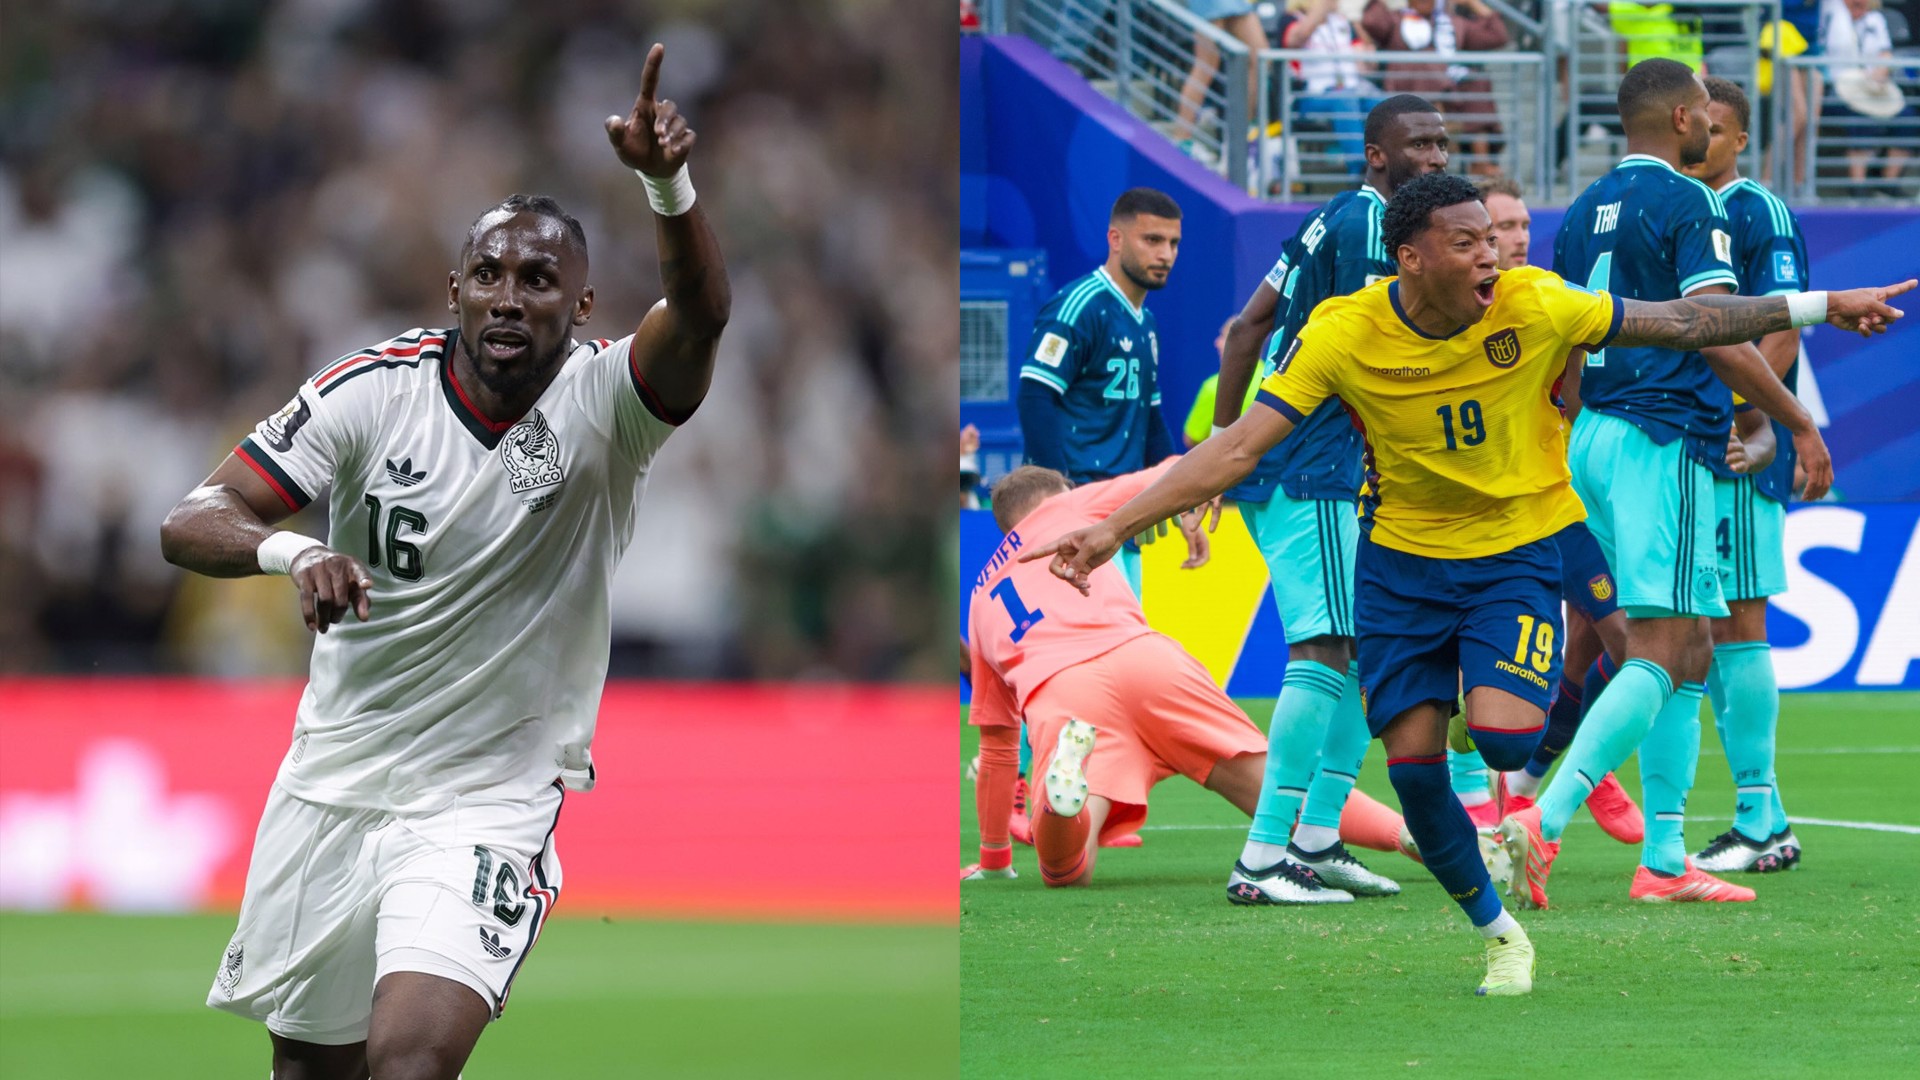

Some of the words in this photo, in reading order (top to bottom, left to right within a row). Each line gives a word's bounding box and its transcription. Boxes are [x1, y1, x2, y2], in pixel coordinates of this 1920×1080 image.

[1593, 201, 1622, 234] TAH
[1103, 358, 1139, 399] 26
[1369, 366, 1431, 377] marathon
[1436, 400, 1487, 451] 19
[513, 471, 561, 491] MÉXICO
[364, 494, 429, 583] 16
[989, 576, 1045, 644] 1
[1514, 614, 1554, 673] 19
[1495, 660, 1549, 690] marathon
[472, 843, 528, 928] 16
